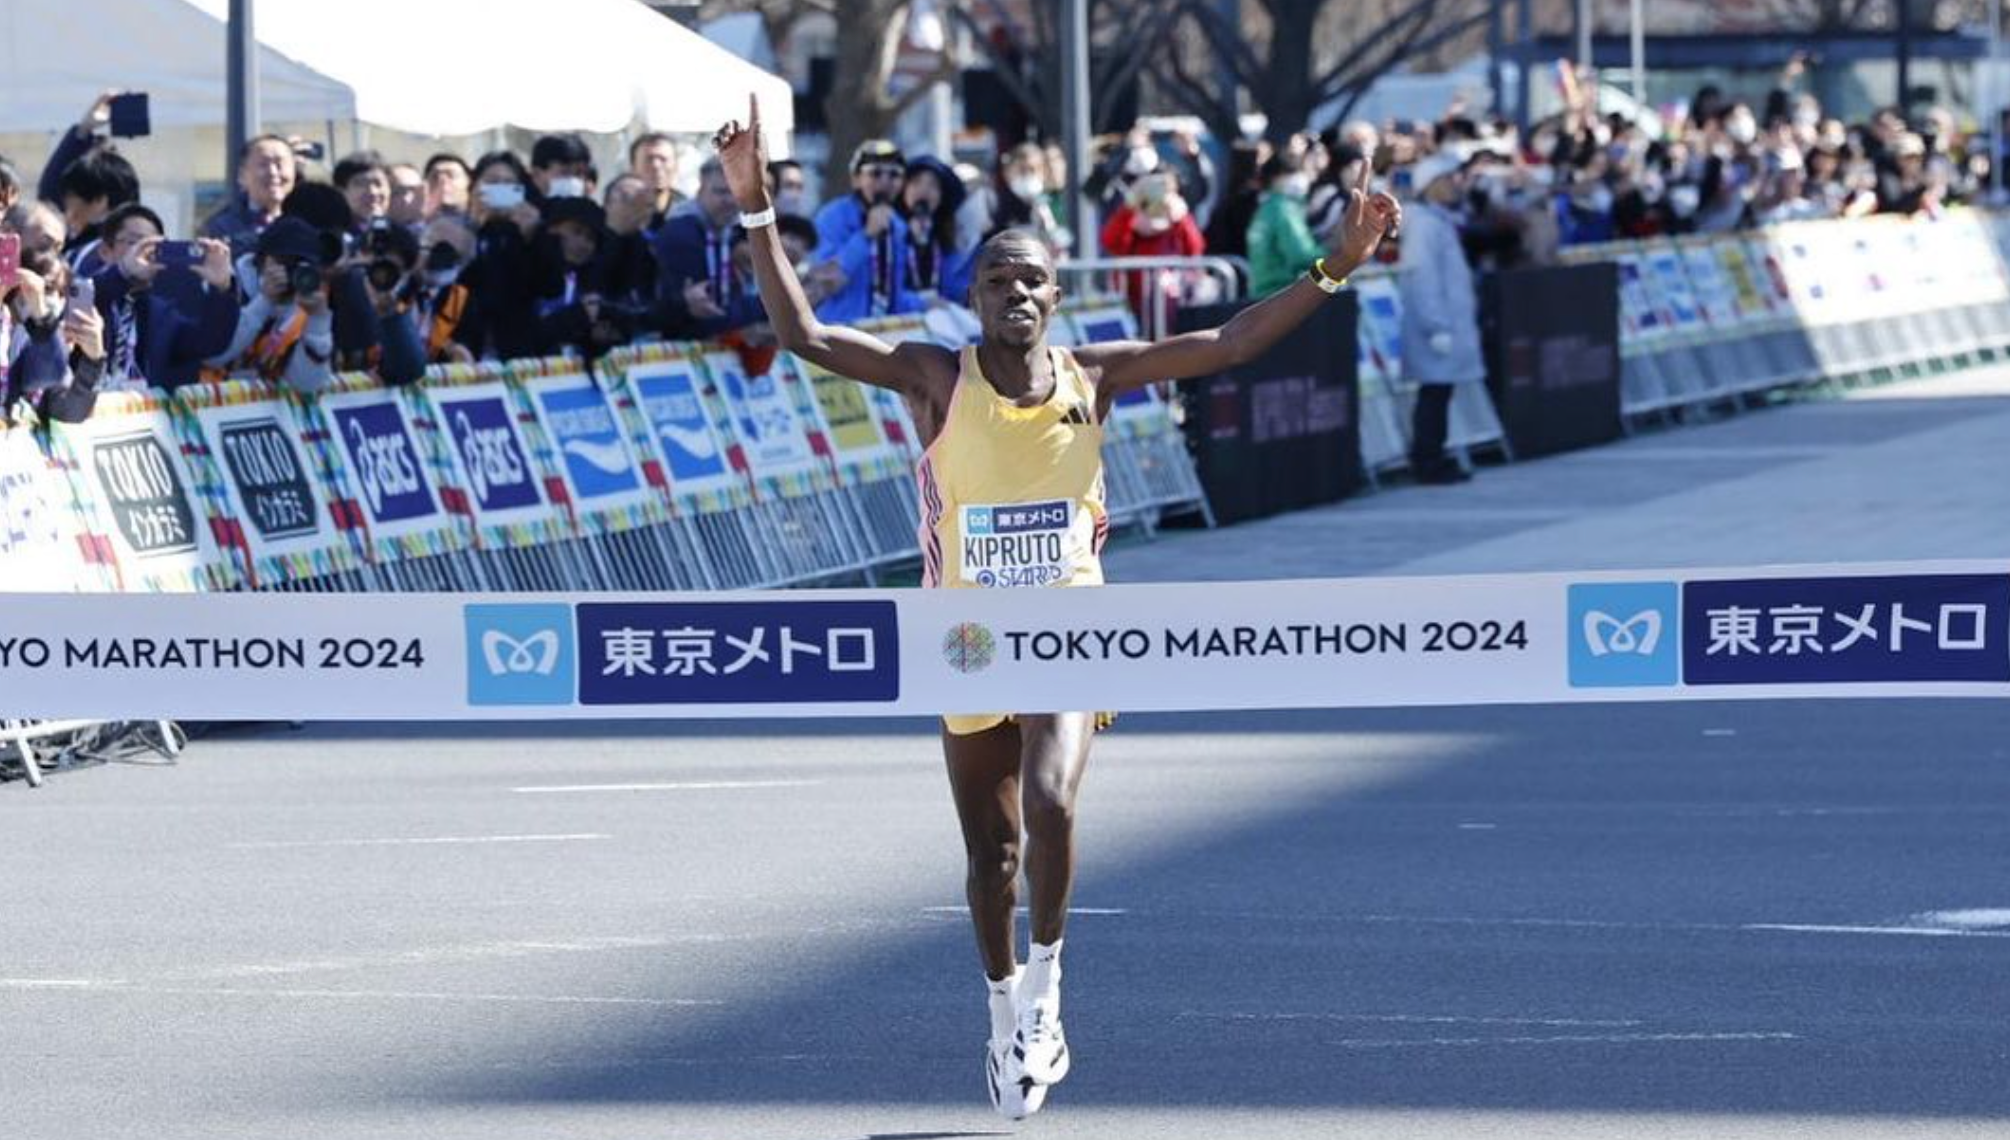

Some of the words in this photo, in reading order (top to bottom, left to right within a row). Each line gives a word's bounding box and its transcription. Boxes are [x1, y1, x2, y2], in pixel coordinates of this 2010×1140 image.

[96, 441, 173, 501] TOKIO
[225, 430, 296, 486] TOKIO
[964, 533, 1061, 568] KIPRUTO
[65, 638, 304, 668] MARATHON
[319, 638, 424, 668] 2024
[601, 627, 875, 677] 東京メトロ
[1005, 629, 1150, 661] TOKYO
[1165, 623, 1405, 658] MARATHON
[1421, 621, 1529, 652] 2024
[1706, 603, 1987, 656] 東京メトロ
